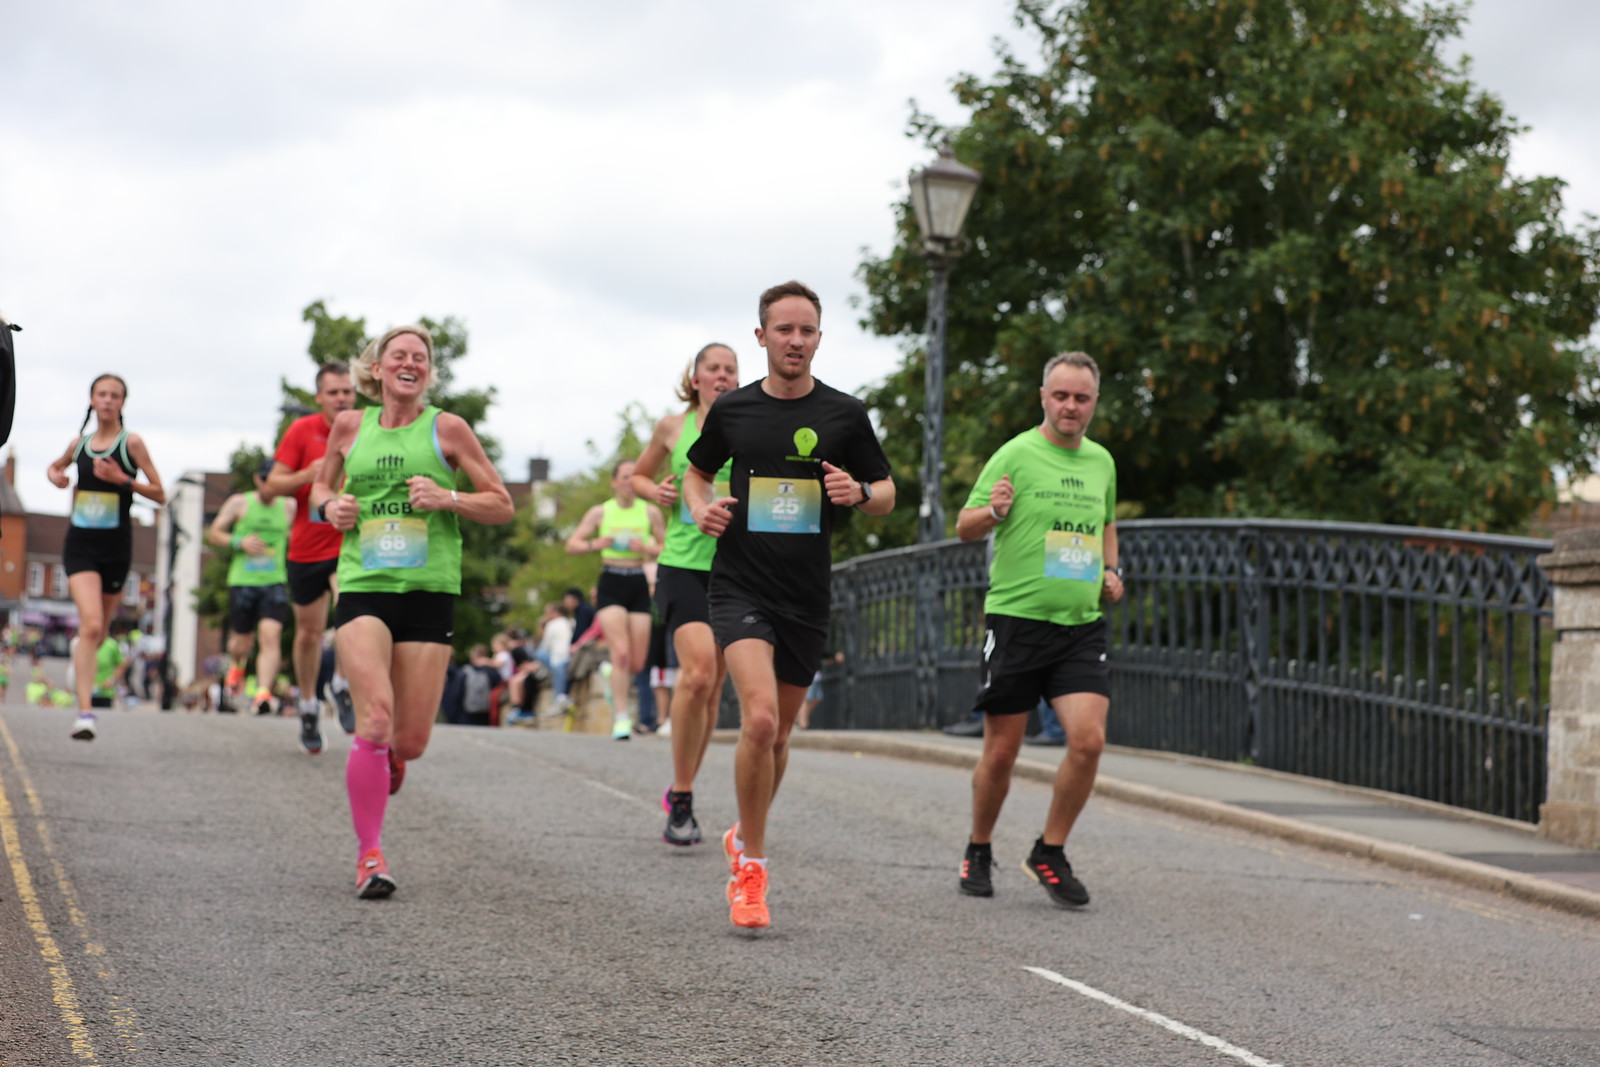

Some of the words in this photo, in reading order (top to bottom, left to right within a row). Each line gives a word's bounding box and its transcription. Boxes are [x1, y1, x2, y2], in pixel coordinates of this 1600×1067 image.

[1034, 490, 1071, 500] REDWAY
[371, 502, 413, 516] MGB
[772, 497, 800, 515] 25
[1053, 520, 1096, 536] ADAM
[379, 535, 407, 551] 68
[1059, 547, 1093, 566] 204
